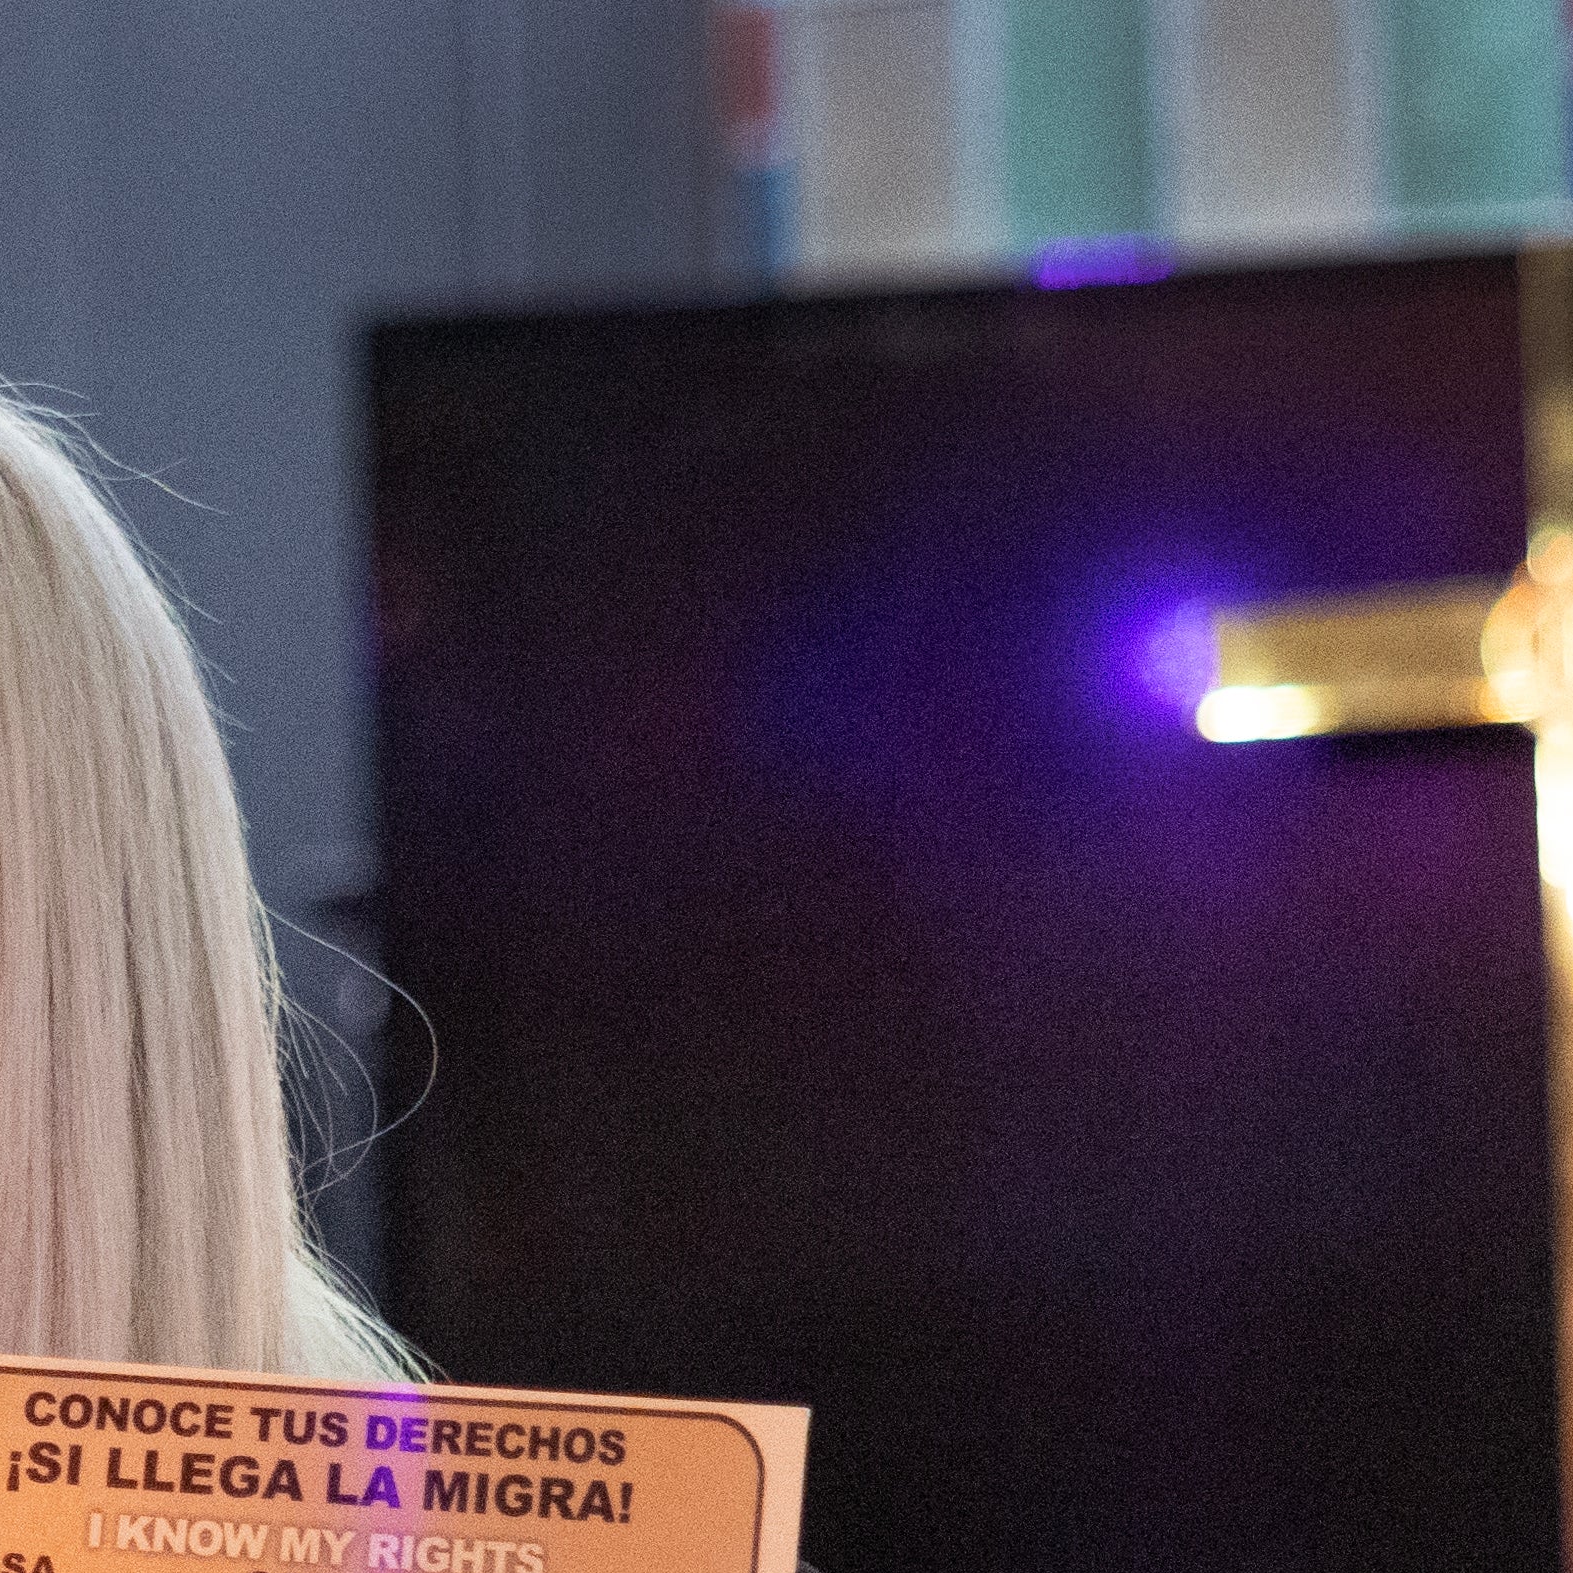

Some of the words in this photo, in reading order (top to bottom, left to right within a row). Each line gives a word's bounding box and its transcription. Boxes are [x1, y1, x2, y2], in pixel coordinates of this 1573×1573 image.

[23, 1390, 234, 1440] CONOCE
[248, 1406, 350, 1448] TUS
[364, 1413, 627, 1466] DERECHOS
[6, 1439, 83, 1496] ¡SI
[105, 1446, 306, 1502] LLEGA
[325, 1462, 403, 1508] LA
[422, 1468, 633, 1524] MIGRA!
[86, 1513, 103, 1547] I
[115, 1515, 266, 1560] KNOW
[278, 1526, 355, 1566] MY
